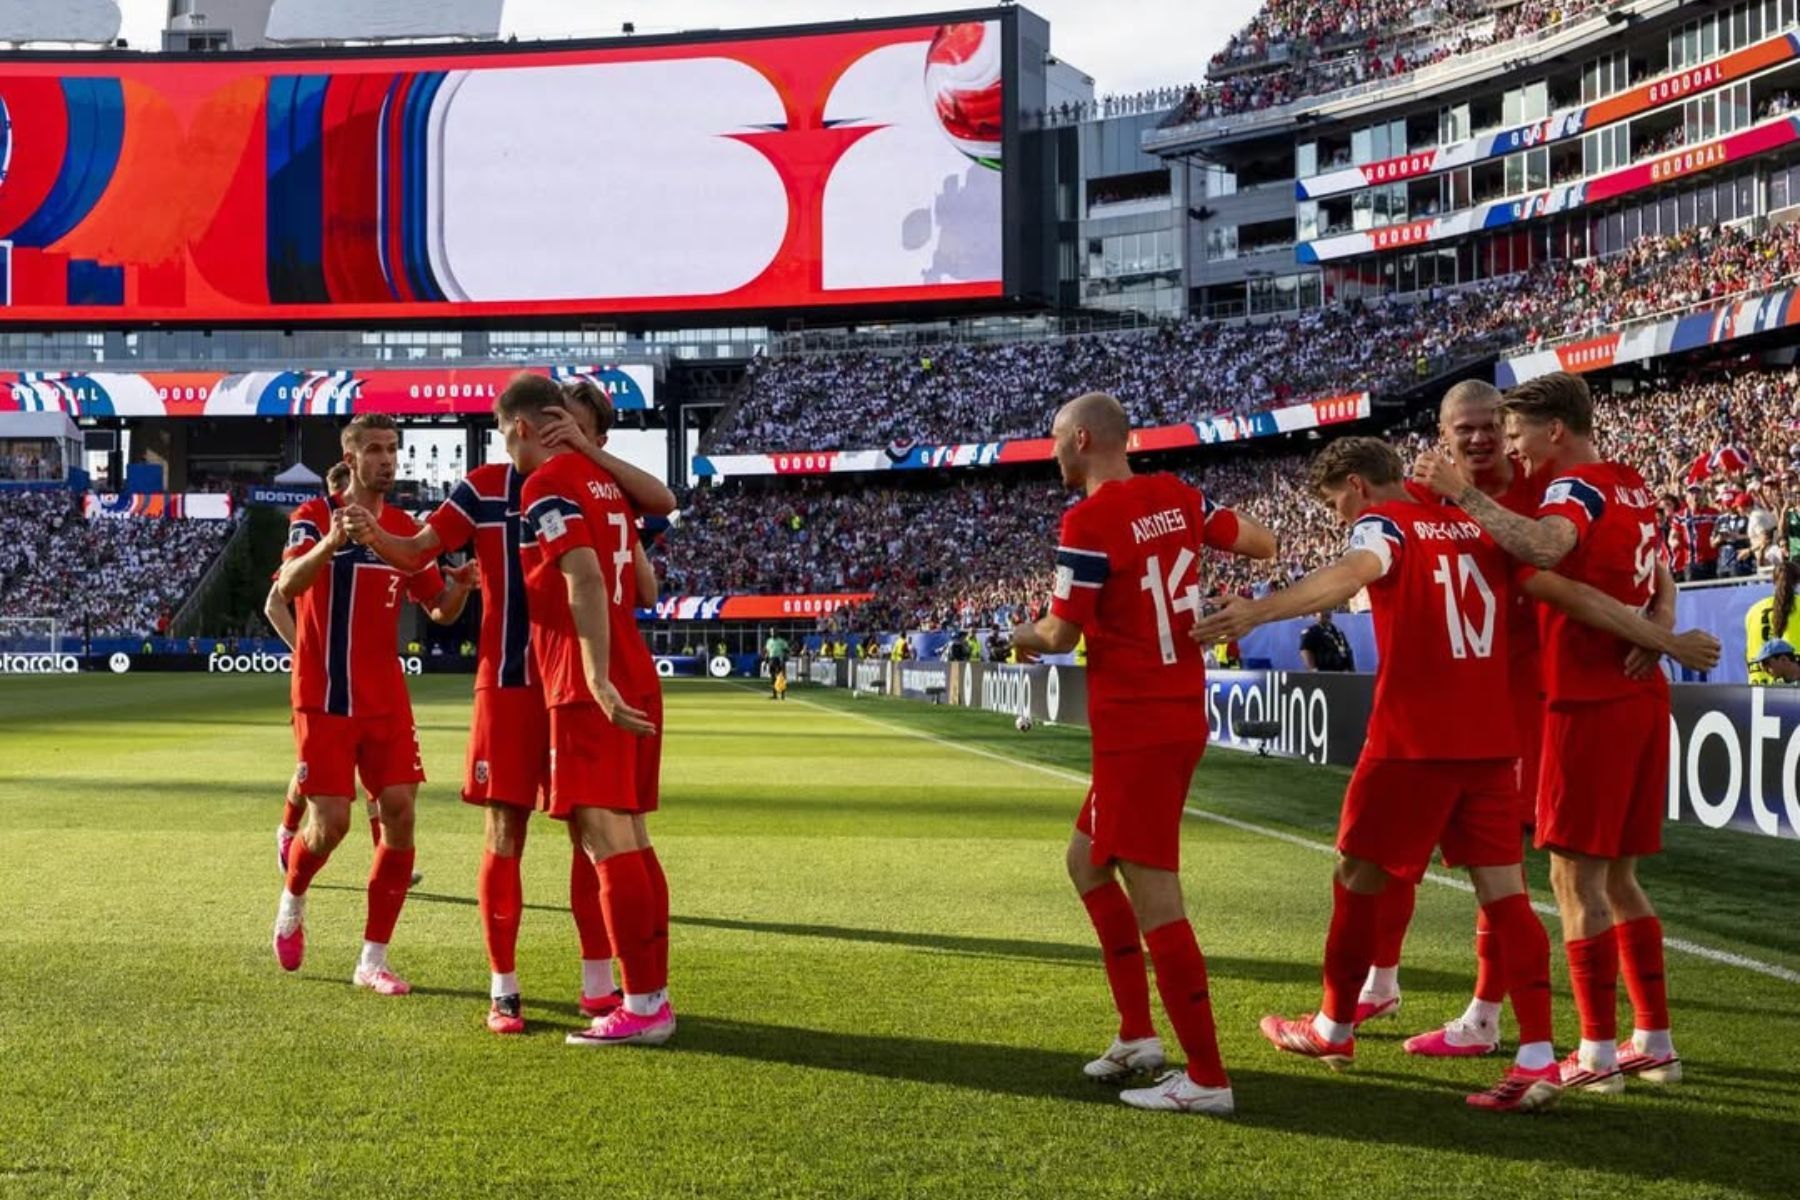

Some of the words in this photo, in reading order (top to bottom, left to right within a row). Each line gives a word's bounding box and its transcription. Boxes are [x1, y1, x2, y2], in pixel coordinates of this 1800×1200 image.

[1649, 63, 1722, 102] GOOOOAL
[1365, 156, 1430, 181] GOOOOA
[1651, 144, 1725, 180] GOOOOAL
[409, 384, 496, 398] GOOOOAL
[608, 512, 633, 605] 7
[385, 575, 400, 608] 3
[784, 600, 849, 613] GOOOOA
[1141, 546, 1200, 665] 14
[1433, 553, 1496, 659] 10
[0, 652, 79, 673] torola
[1228, 671, 1328, 765] calling
